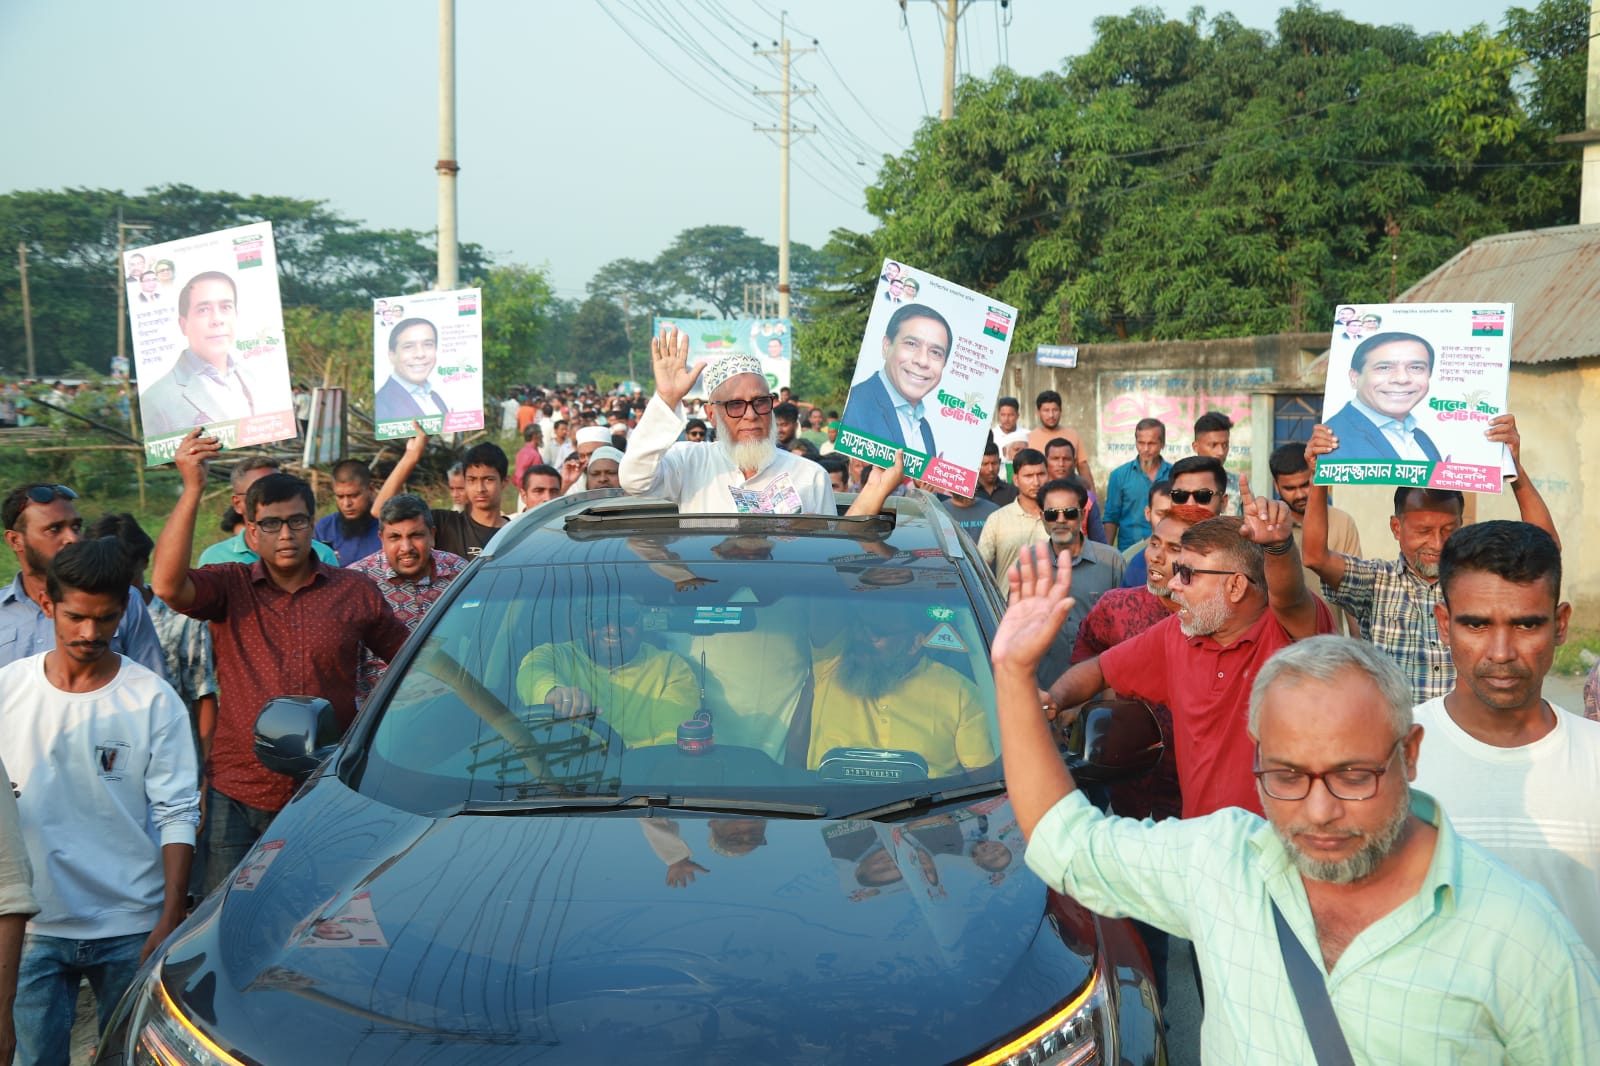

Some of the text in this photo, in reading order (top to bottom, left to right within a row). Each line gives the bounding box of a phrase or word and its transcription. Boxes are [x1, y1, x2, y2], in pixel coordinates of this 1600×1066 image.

[937, 388, 966, 408] ধানের
[1429, 397, 1467, 412] ধানের
[941, 406, 979, 425] ভোট দিন
[1437, 410, 1489, 422] ভোট দিন
[1319, 463, 1428, 484] মাসুদুজ্জামান মাসুদ
[1441, 470, 1488, 482] বিএনপি
